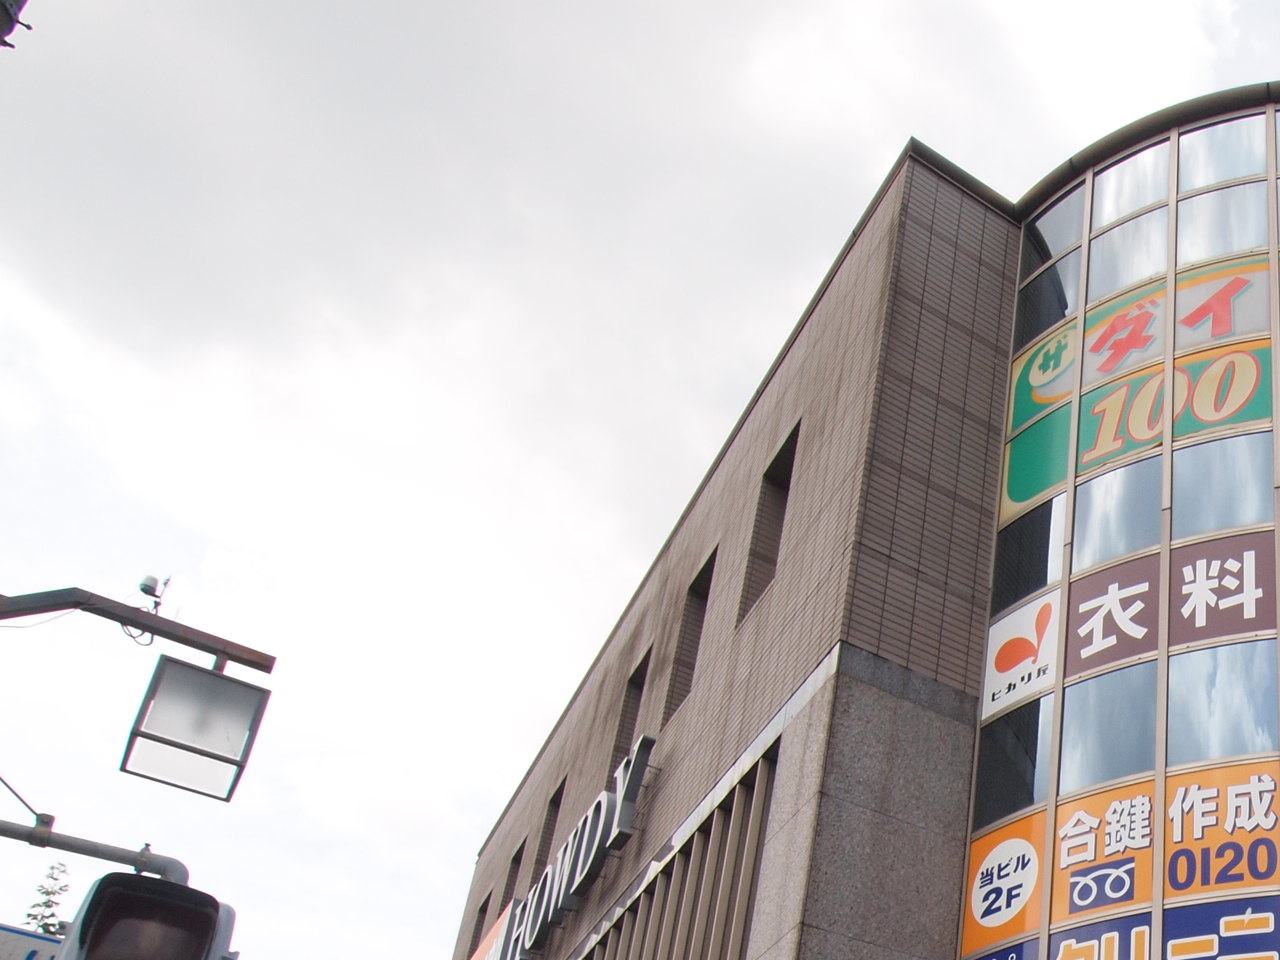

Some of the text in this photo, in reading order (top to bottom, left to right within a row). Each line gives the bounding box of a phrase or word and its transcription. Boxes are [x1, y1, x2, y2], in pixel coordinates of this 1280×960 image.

[1081, 351, 1262, 467] 100
[979, 854, 1031, 888] 当ビル
[981, 886, 1022, 919] 2F
